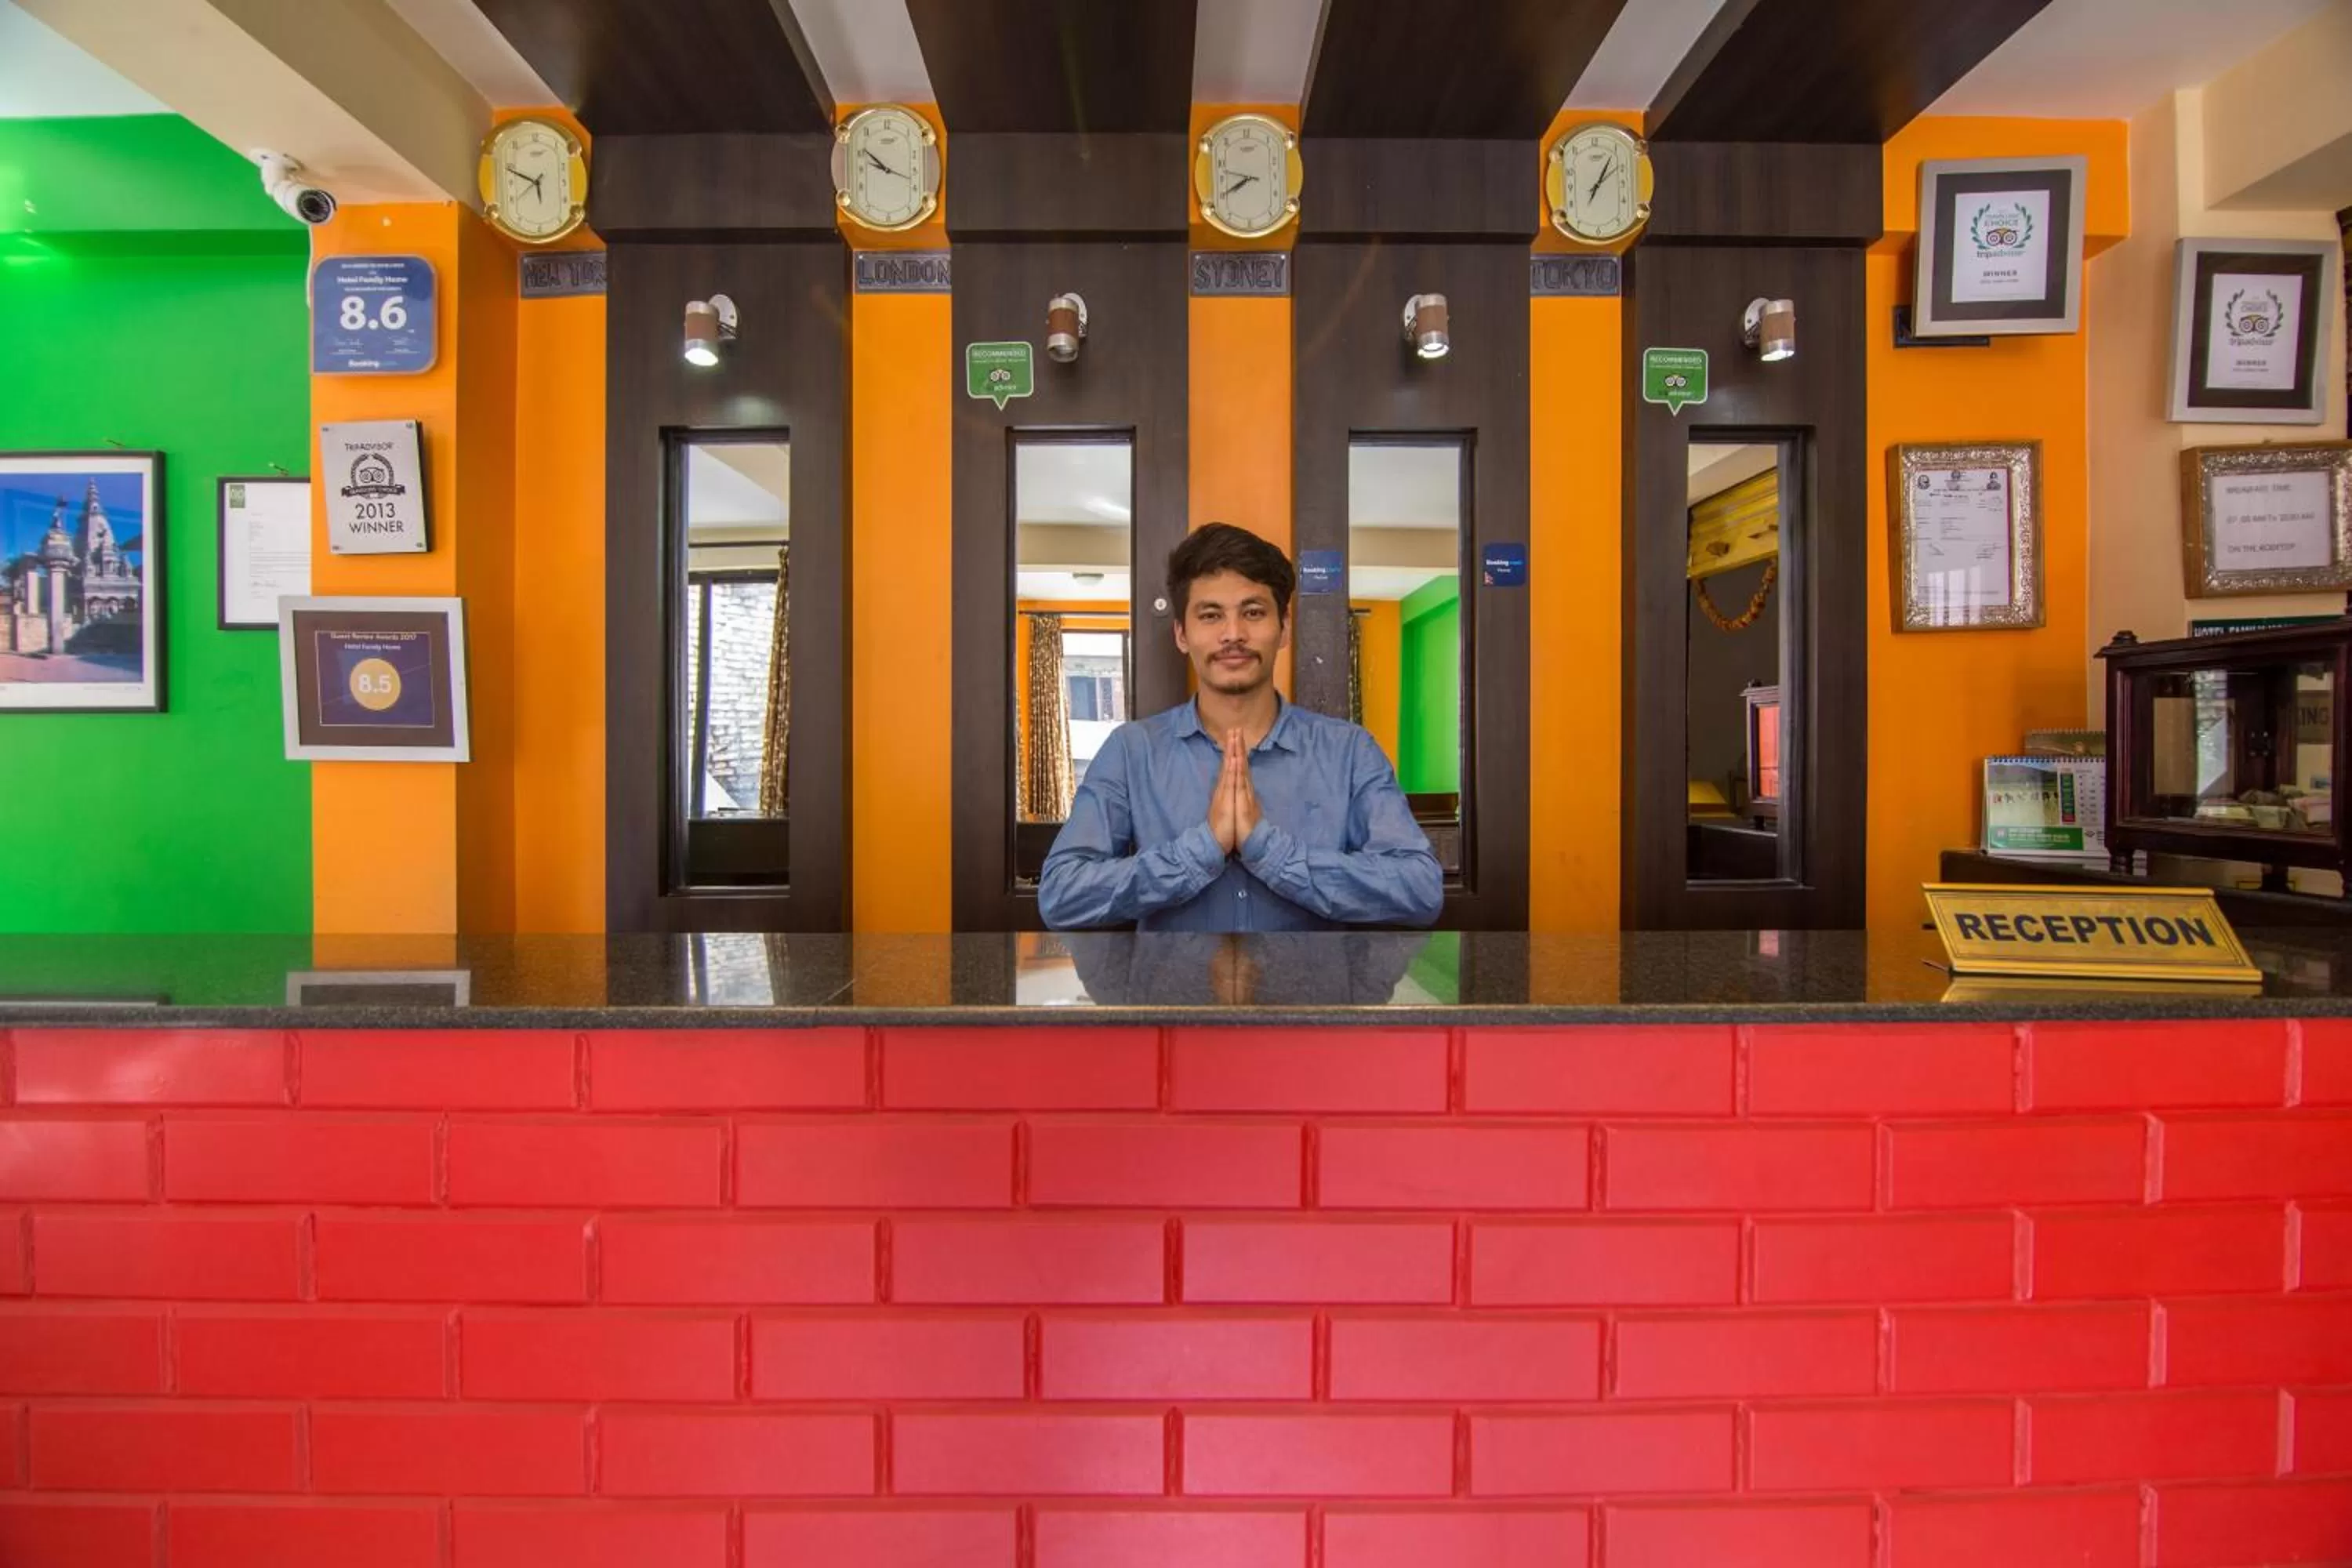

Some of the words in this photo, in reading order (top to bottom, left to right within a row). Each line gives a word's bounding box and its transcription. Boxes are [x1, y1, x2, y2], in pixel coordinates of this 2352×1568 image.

[568, 260, 606, 286] YOR
[858, 259, 951, 285] LONDON
[1194, 259, 1286, 289] SYDNEY
[1530, 259, 1619, 289] TOKYO
[340, 296, 407, 330] 8.6
[355, 503, 396, 519] 2013
[349, 520, 404, 533] WINNER
[358, 673, 392, 693] 8.5
[1955, 913, 2218, 946] RECEPTION
